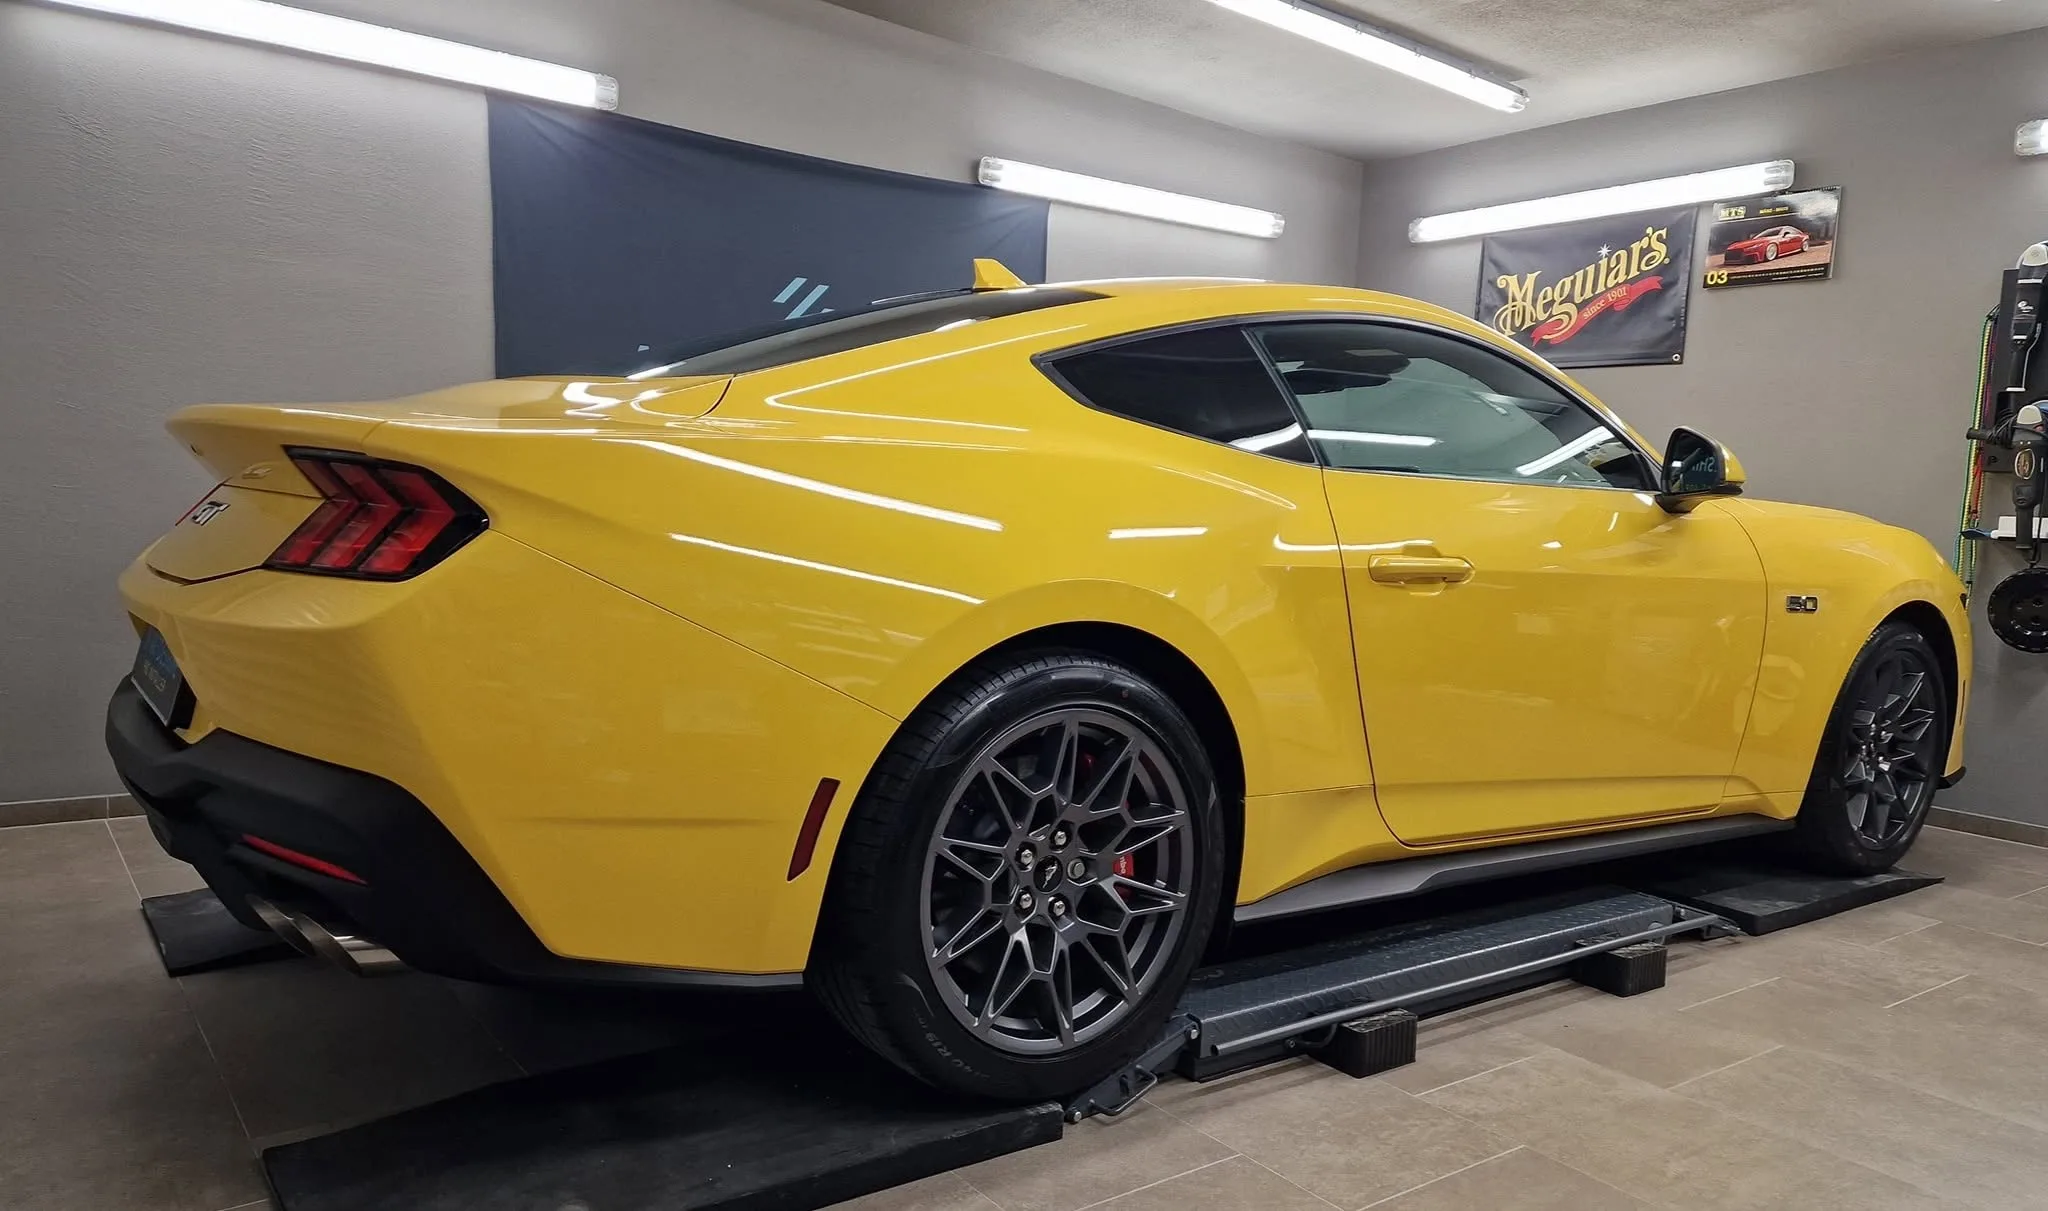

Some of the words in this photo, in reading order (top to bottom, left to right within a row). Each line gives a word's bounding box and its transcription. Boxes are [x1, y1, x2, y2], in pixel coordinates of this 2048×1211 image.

[1494, 226, 1668, 340] Meguiar's
[1707, 270, 1728, 285] 03
[1583, 299, 1605, 320] since
[1607, 286, 1627, 305] 1901
[191, 501, 231, 526] GT
